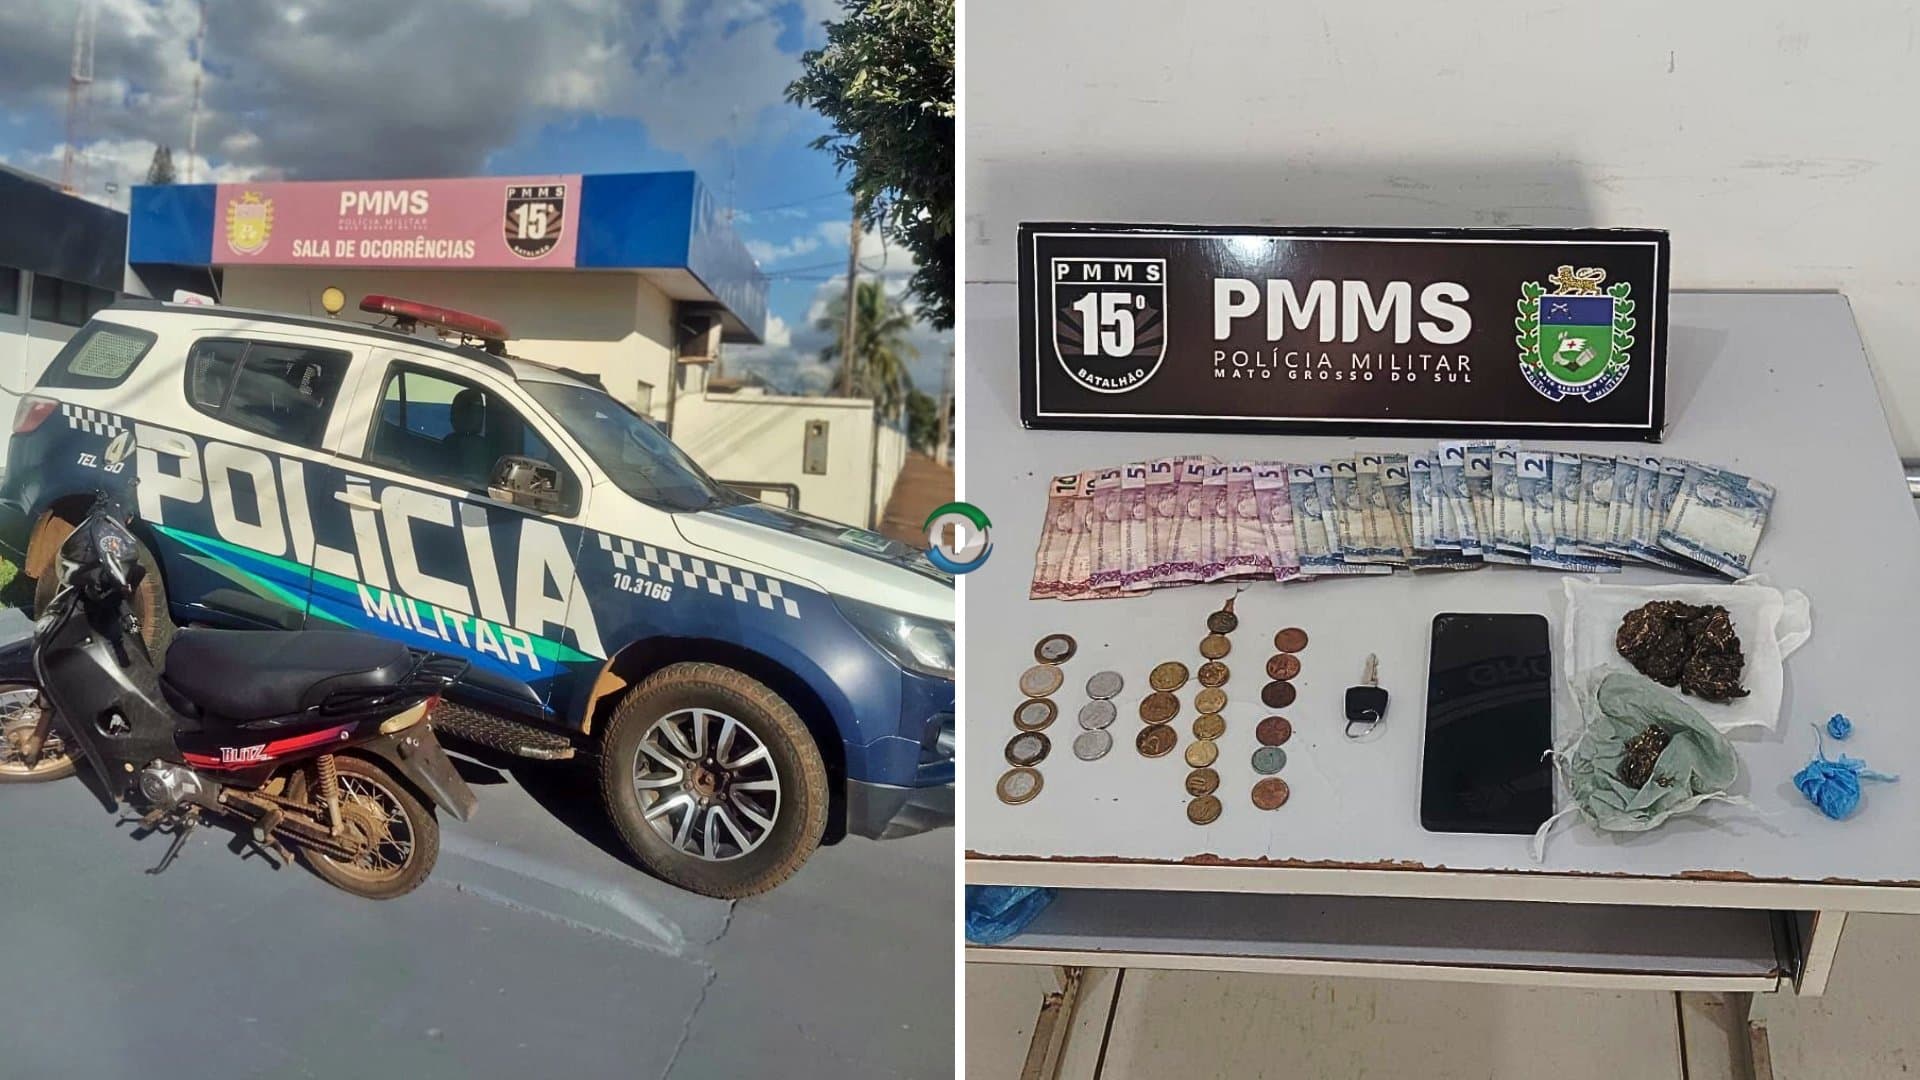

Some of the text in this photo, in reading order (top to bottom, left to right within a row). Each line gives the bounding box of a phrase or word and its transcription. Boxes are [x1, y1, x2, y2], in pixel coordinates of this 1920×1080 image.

[509, 187, 563, 198] PMMS
[340, 189, 429, 216] PMMS
[292, 235, 476, 259] SALA DE OCORRÊNCIAS
[1057, 263, 1161, 281] PMMS
[1213, 278, 1472, 345] PMMS
[1214, 347, 1472, 371] POLÍCIA MILITAR
[1078, 367, 1145, 388] BATALHÃO
[1214, 368, 1472, 383] MATO GROSSO DO SUL
[77, 452, 98, 468] TEL
[1446, 446, 1465, 460] 2
[1499, 450, 1517, 461] 2
[1151, 462, 1171, 473] 5
[1232, 462, 1252, 473] 5
[1337, 461, 1357, 473] 2
[1363, 455, 1382, 467] 2
[1471, 457, 1491, 473] 2
[1524, 457, 1544, 473] 2
[1127, 467, 1146, 479] 5
[1188, 464, 1204, 475] 5
[1258, 470, 1279, 478] 5
[1294, 465, 1314, 477] 2
[1386, 466, 1407, 479] 2
[613, 571, 673, 602] 10.3166
[357, 583, 541, 672] MILITAR
